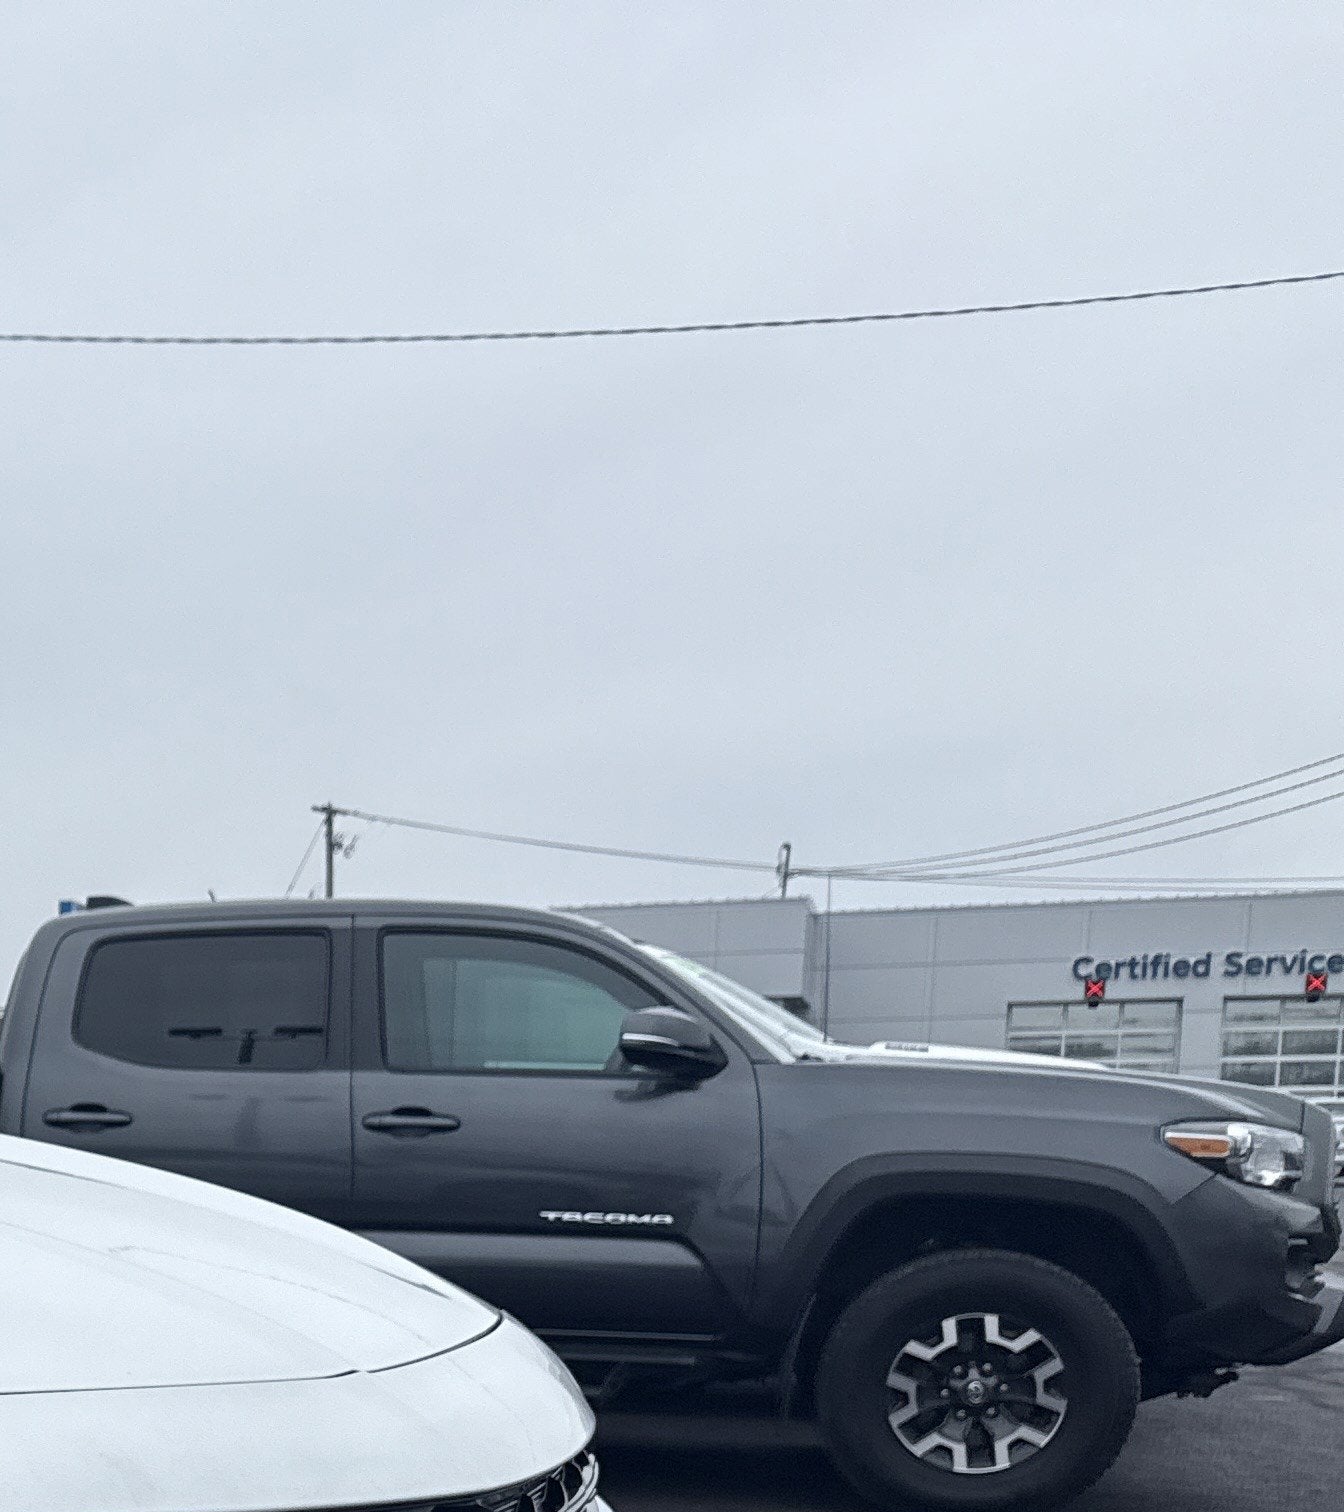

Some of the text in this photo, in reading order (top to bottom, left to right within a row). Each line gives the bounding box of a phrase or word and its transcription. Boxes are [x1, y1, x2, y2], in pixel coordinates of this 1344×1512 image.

[1072, 948, 1344, 981] Certified Service
[539, 1210, 675, 1225] TACOMA
